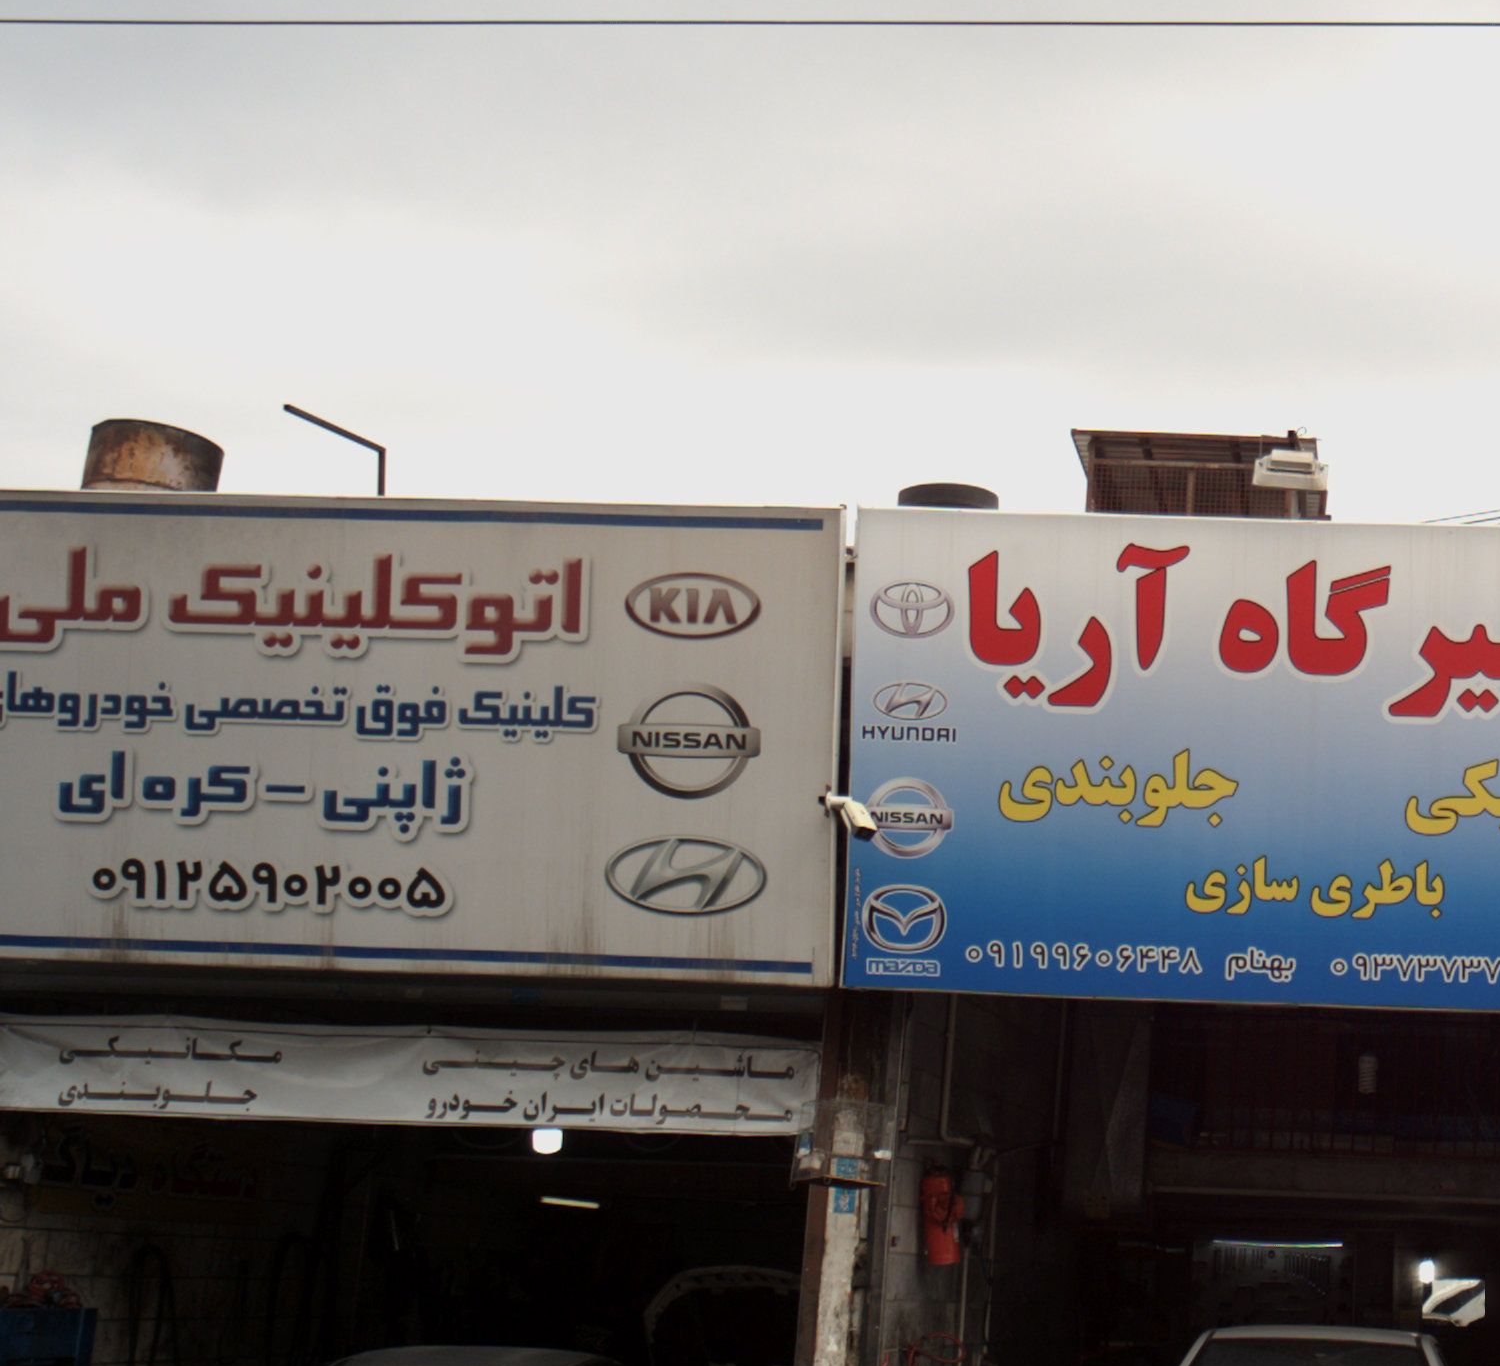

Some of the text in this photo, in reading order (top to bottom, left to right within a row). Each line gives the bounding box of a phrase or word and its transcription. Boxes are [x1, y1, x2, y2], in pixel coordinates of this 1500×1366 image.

[0, 545, 584, 656] اتوکلینیک ملی
[648, 586, 739, 626] KIA
[967, 542, 1191, 707] آریا
[0, 670, 598, 739] کلینیک فوق تخصصی خودروها
[630, 730, 748, 752] NISSAN
[861, 725, 957, 743] HYUNDAI
[322, 756, 467, 834] ژاپنی
[998, 747, 1239, 828] جلوبندی
[871, 810, 944, 826] NISSAN
[91, 856, 447, 910] ۰۹۱۲۵۹۰۲۰۰۵
[1185, 854, 1446, 920] باطری سازی
[966, 941, 1297, 982] بهنام ۰۹۱۹۹۶۰۶۴۴۸
[58, 1035, 284, 1066] مکانیکی
[421, 1048, 797, 1083] ماشین های چینی
[57, 1080, 258, 1112] جلوبندی
[424, 1089, 795, 1125] محصولات ایران خودرو
